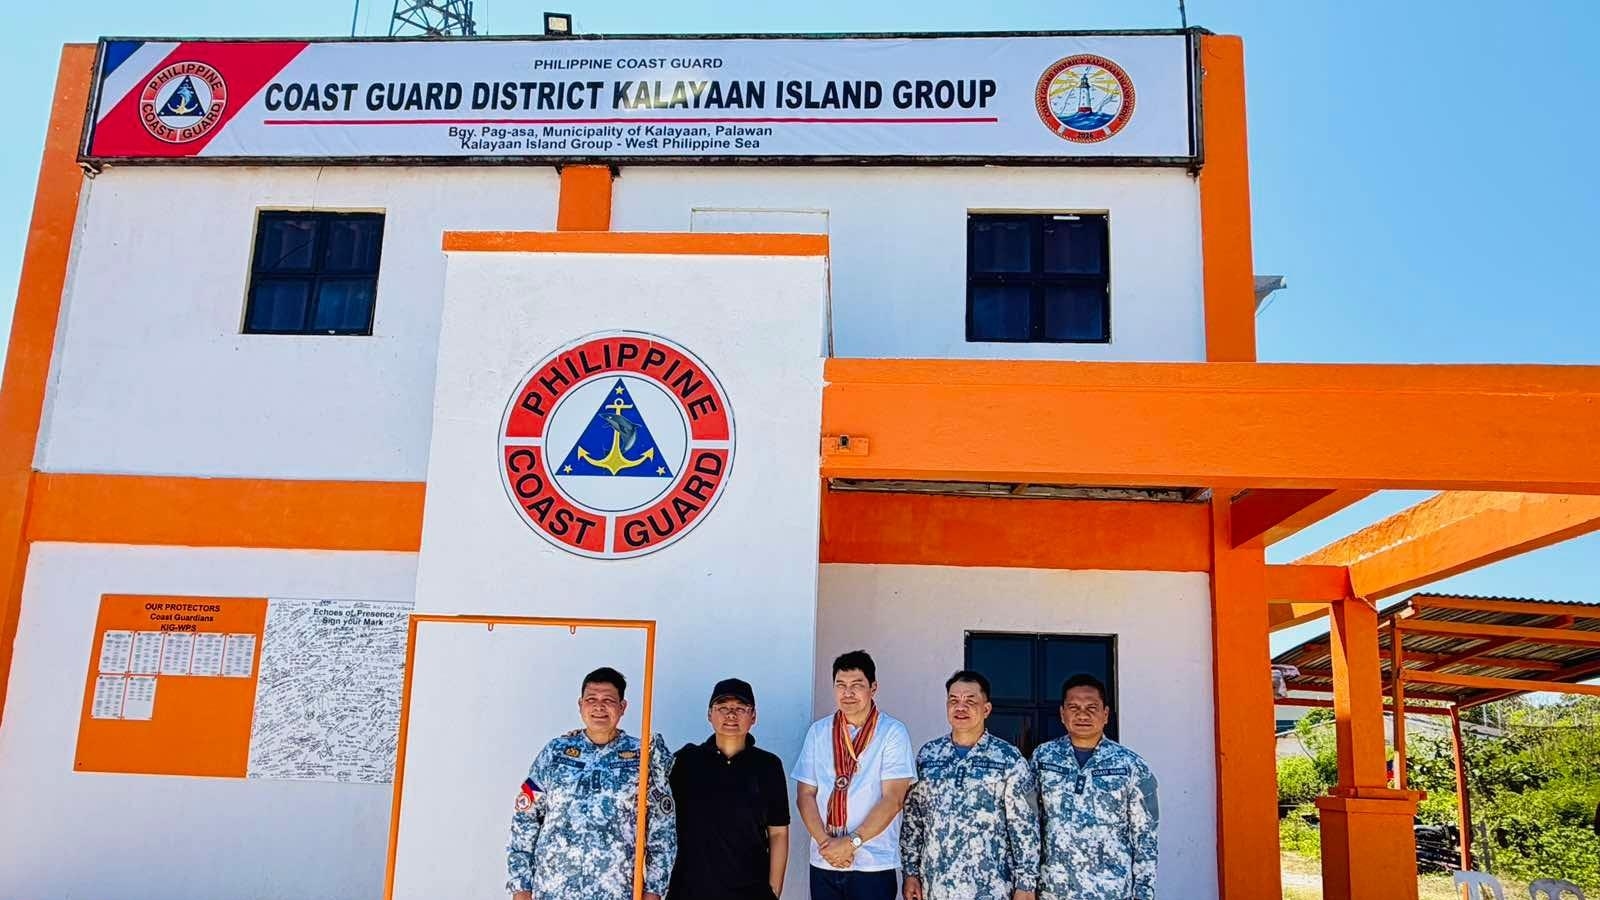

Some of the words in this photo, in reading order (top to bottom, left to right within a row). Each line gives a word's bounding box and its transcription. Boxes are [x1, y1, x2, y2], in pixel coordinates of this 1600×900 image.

[534, 59, 612, 70] PHILIPPINE
[616, 58, 667, 69] COAST
[670, 58, 723, 69] GUARD
[149, 63, 223, 92] PHILIPPINE
[265, 83, 358, 112] COAST
[365, 82, 463, 111] GUARD
[471, 81, 604, 111] DISTRICT
[611, 80, 766, 110] KALAYAAN
[776, 80, 882, 109] ISLAND
[892, 79, 998, 109] GROUP
[142, 103, 175, 138] COAST
[182, 103, 221, 139] GUARD
[449, 126, 477, 141] Bgy.
[482, 126, 538, 140] Pag-asa,
[543, 125, 623, 139] Municipality
[627, 125, 642, 136] of
[645, 125, 711, 139] Kalayaan,
[715, 125, 772, 136] Palawan
[461, 138, 521, 152] Kalayaan
[526, 138, 567, 149] Island
[571, 138, 613, 151] Group
[625, 138, 658, 149] West
[662, 138, 730, 151] Philippine
[734, 138, 760, 149] Sea
[521, 343, 718, 421] PHILIPPINE
[508, 449, 596, 545] COAST
[623, 451, 723, 547] GUARD
[145, 603, 163, 611] OUR
[165, 603, 221, 612] PROTECTORS
[313, 608, 343, 617] Echoes
[345, 609, 356, 617] of
[357, 609, 395, 618] Presence
[150, 613, 173, 621] Coast
[174, 614, 214, 622] Guardians
[323, 617, 341, 626] Sign
[343, 618, 361, 627] your
[363, 618, 384, 627] Mark
[160, 624, 197, 632] KIG-WPS
